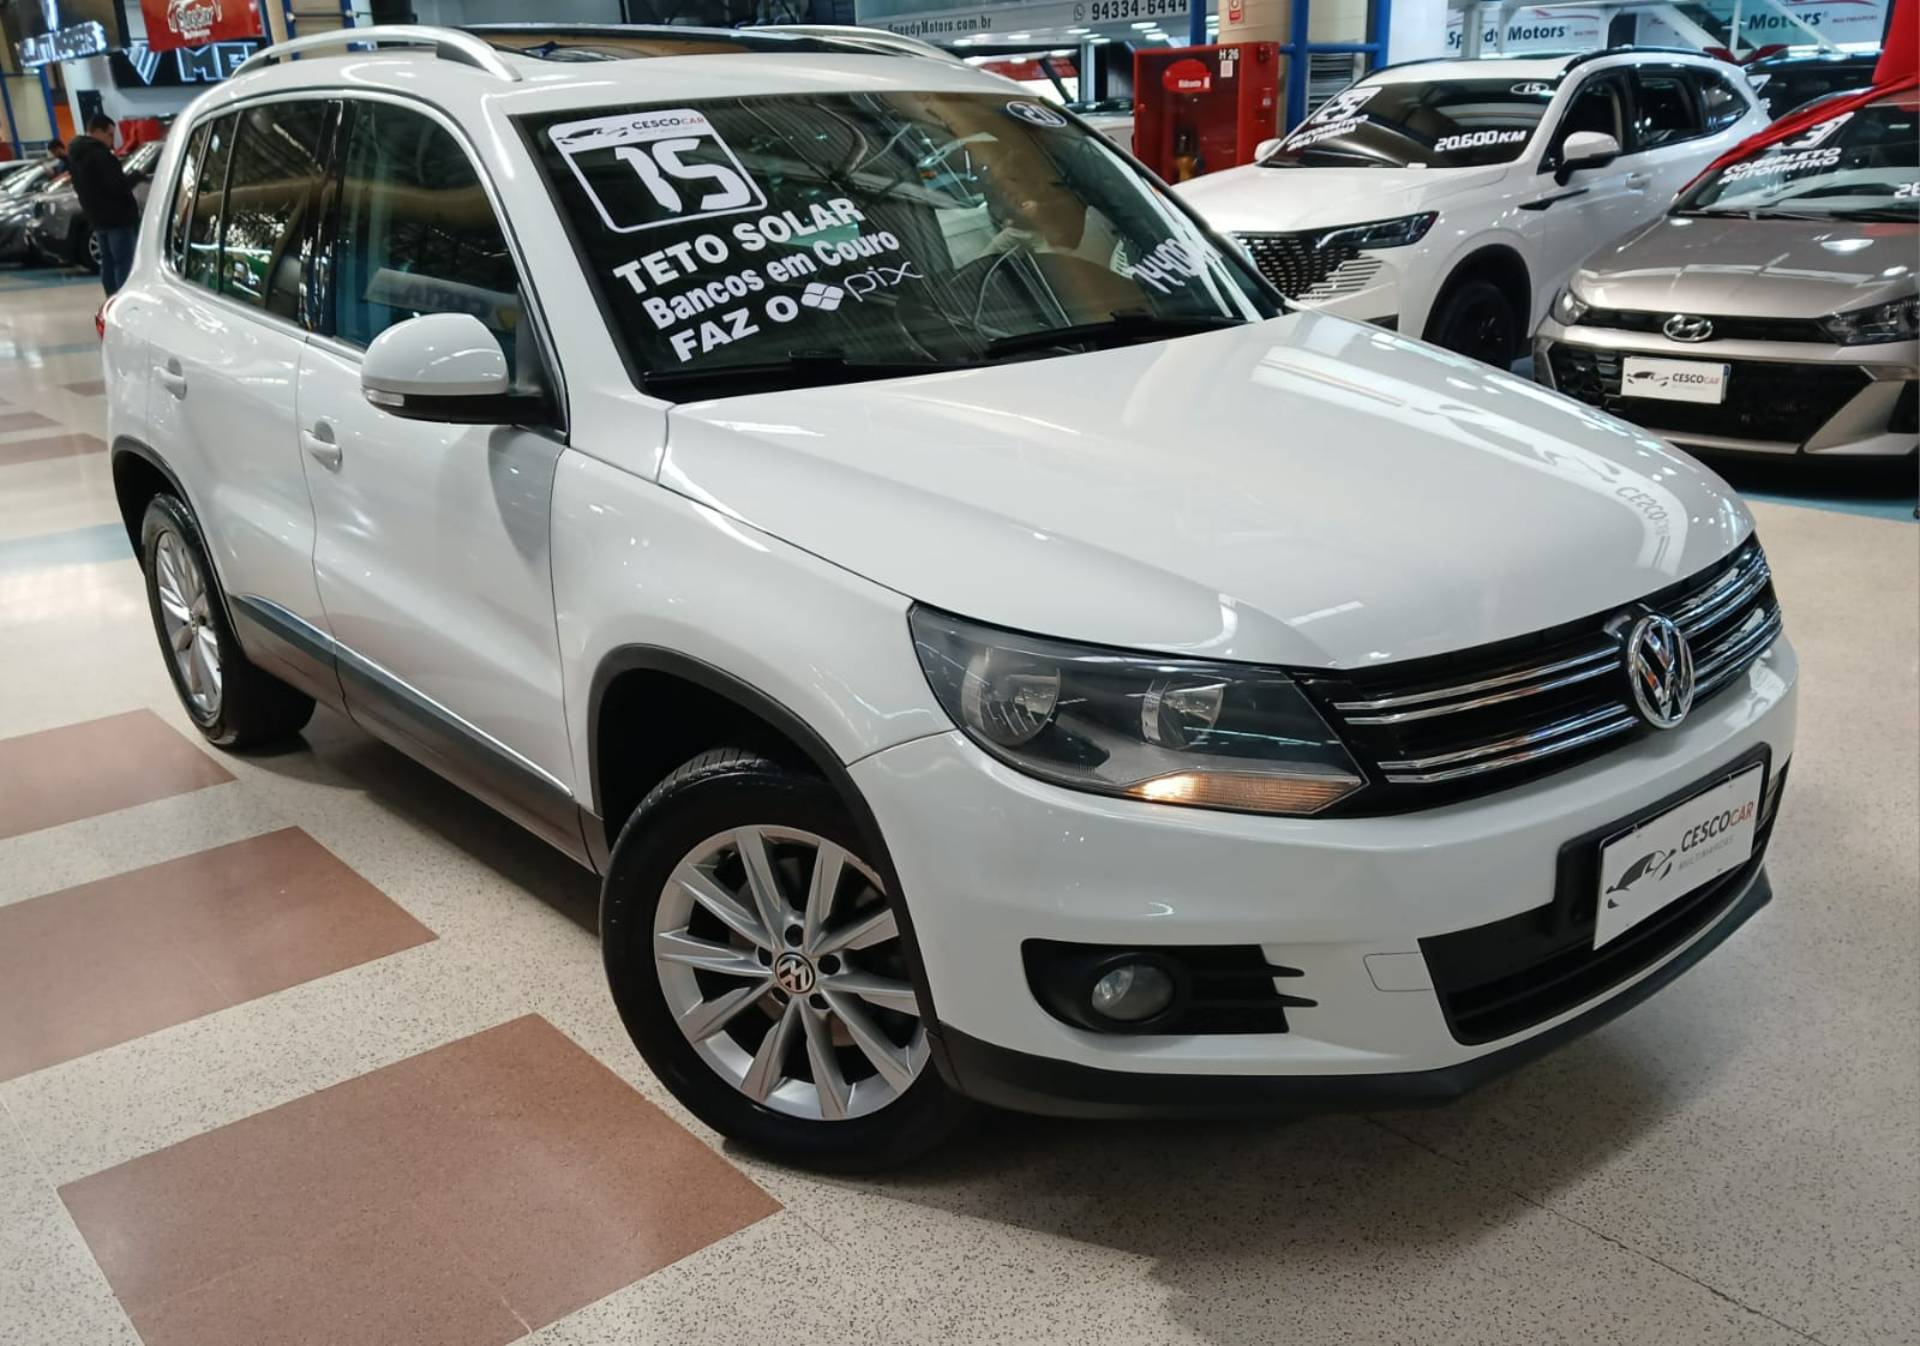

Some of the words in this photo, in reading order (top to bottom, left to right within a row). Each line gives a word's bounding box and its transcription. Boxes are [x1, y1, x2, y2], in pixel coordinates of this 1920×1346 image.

[1219, 48, 1226, 59] H
[1448, 27, 1499, 48] Spdy
[1508, 25, 1565, 41] Motors
[632, 117, 705, 130] CESCOCAR
[614, 137, 751, 213] 15
[612, 234, 729, 294] TETO
[732, 198, 865, 251] SOLAR
[642, 268, 765, 330] Bancos
[766, 251, 817, 282] em
[813, 230, 900, 266] Couro
[669, 307, 760, 363] FAZ
[765, 295, 799, 323] O
[843, 261, 924, 302] pix
[1672, 373, 1719, 385] CESCOCAR
[1681, 801, 1754, 852] CESCOCAR
